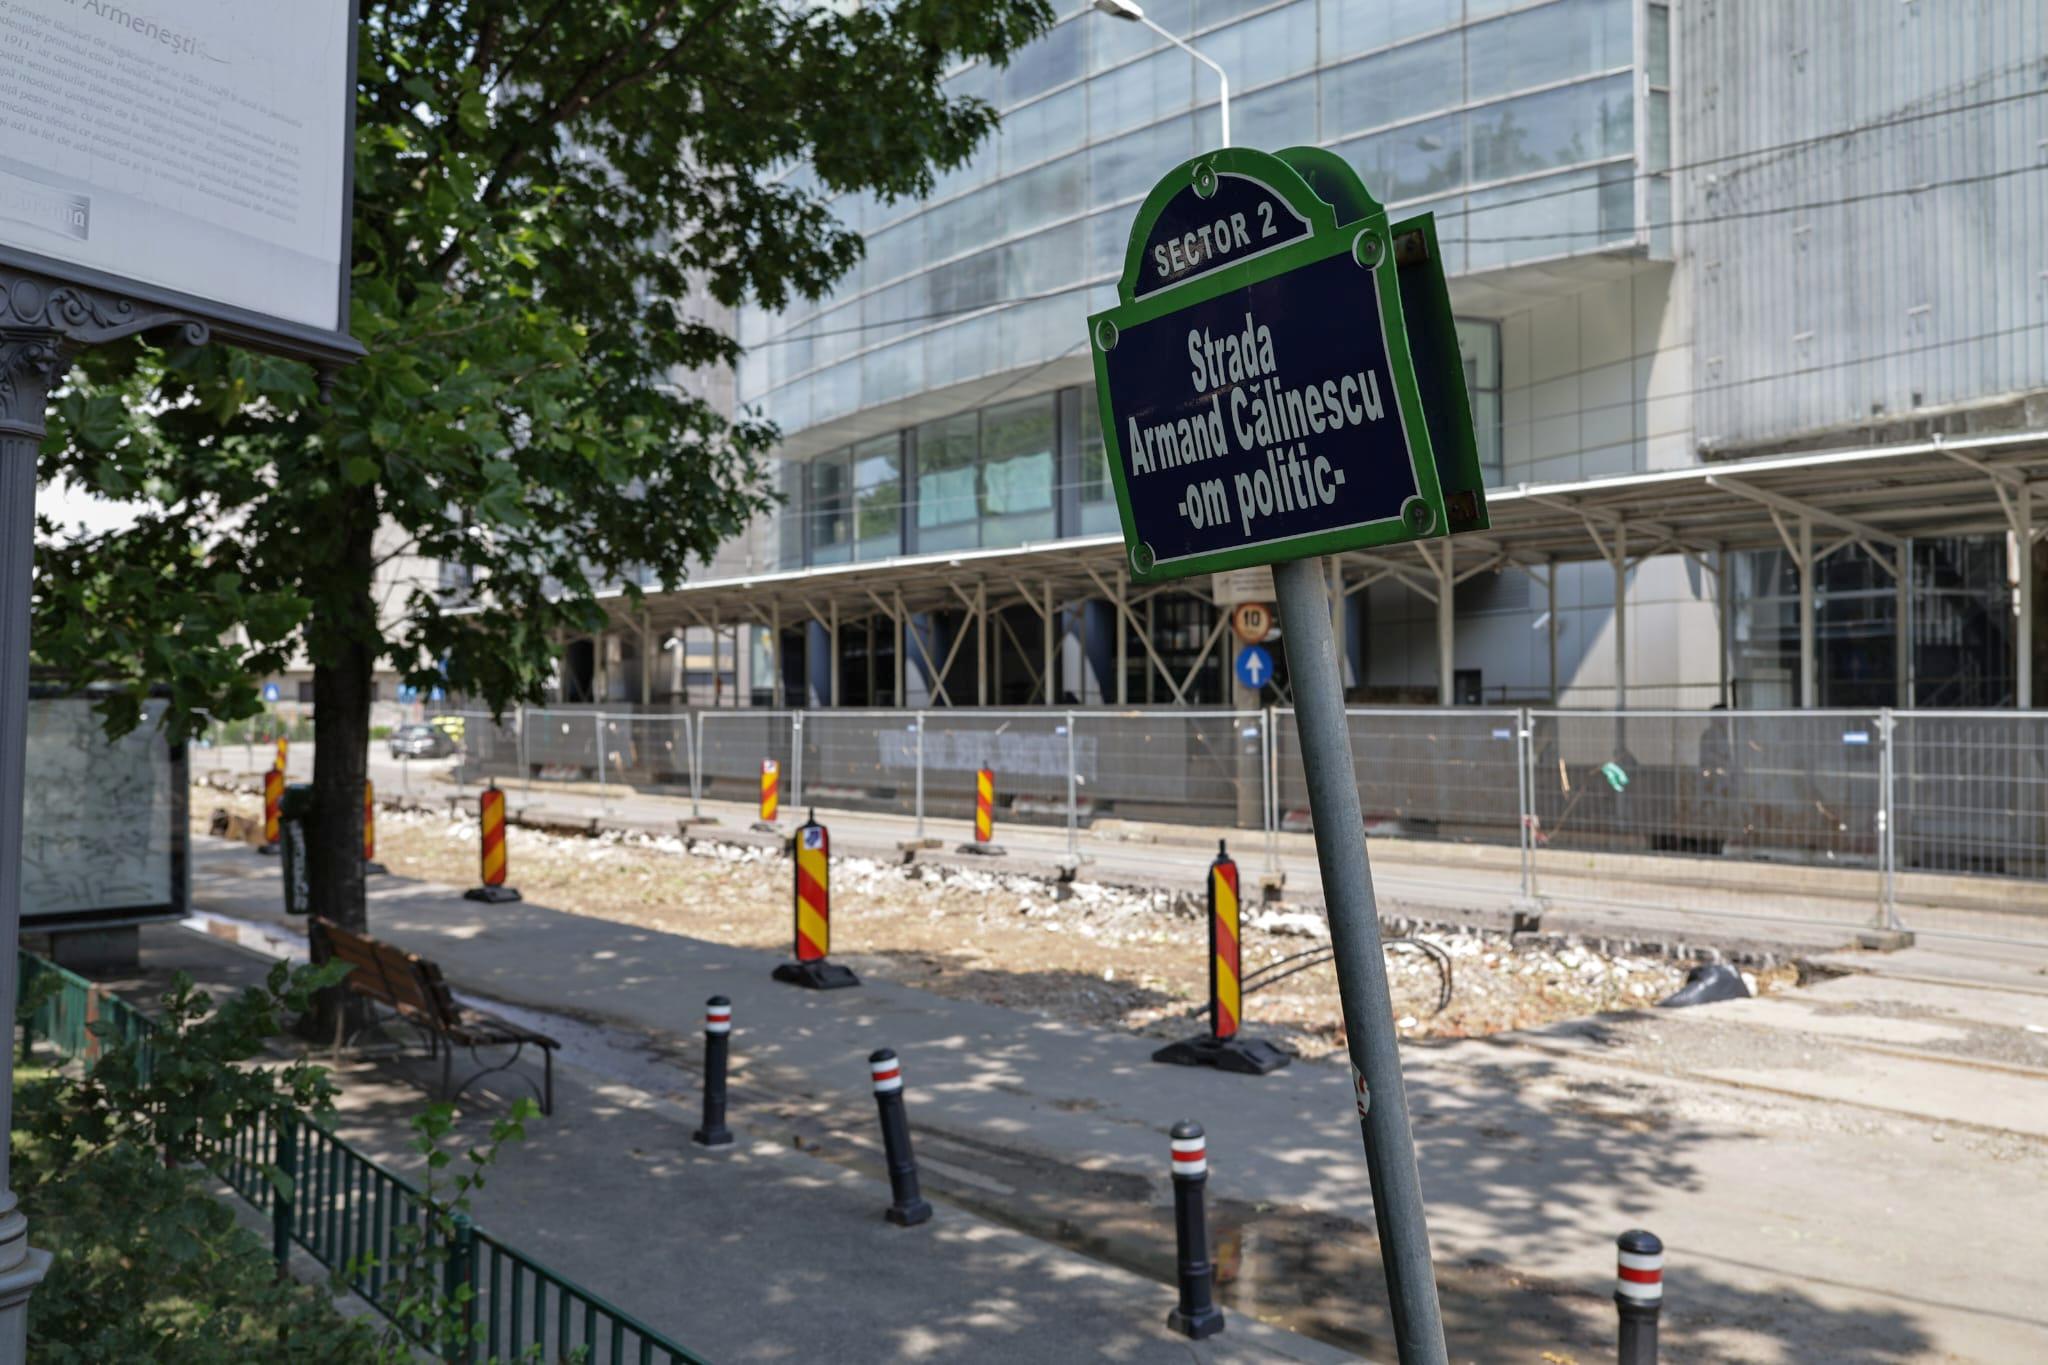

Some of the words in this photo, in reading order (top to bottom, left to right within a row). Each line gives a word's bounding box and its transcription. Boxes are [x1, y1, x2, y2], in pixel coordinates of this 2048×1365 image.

[1154, 212, 1251, 277] SECTOR
[1257, 201, 1278, 239] 2
[1188, 311, 1278, 393] Strada
[1128, 393, 1229, 476] Armand
[1230, 368, 1385, 452] Călinescu
[1178, 478, 1231, 531] -om
[1234, 442, 1347, 537] politic-
[1243, 609, 1261, 627] 10
